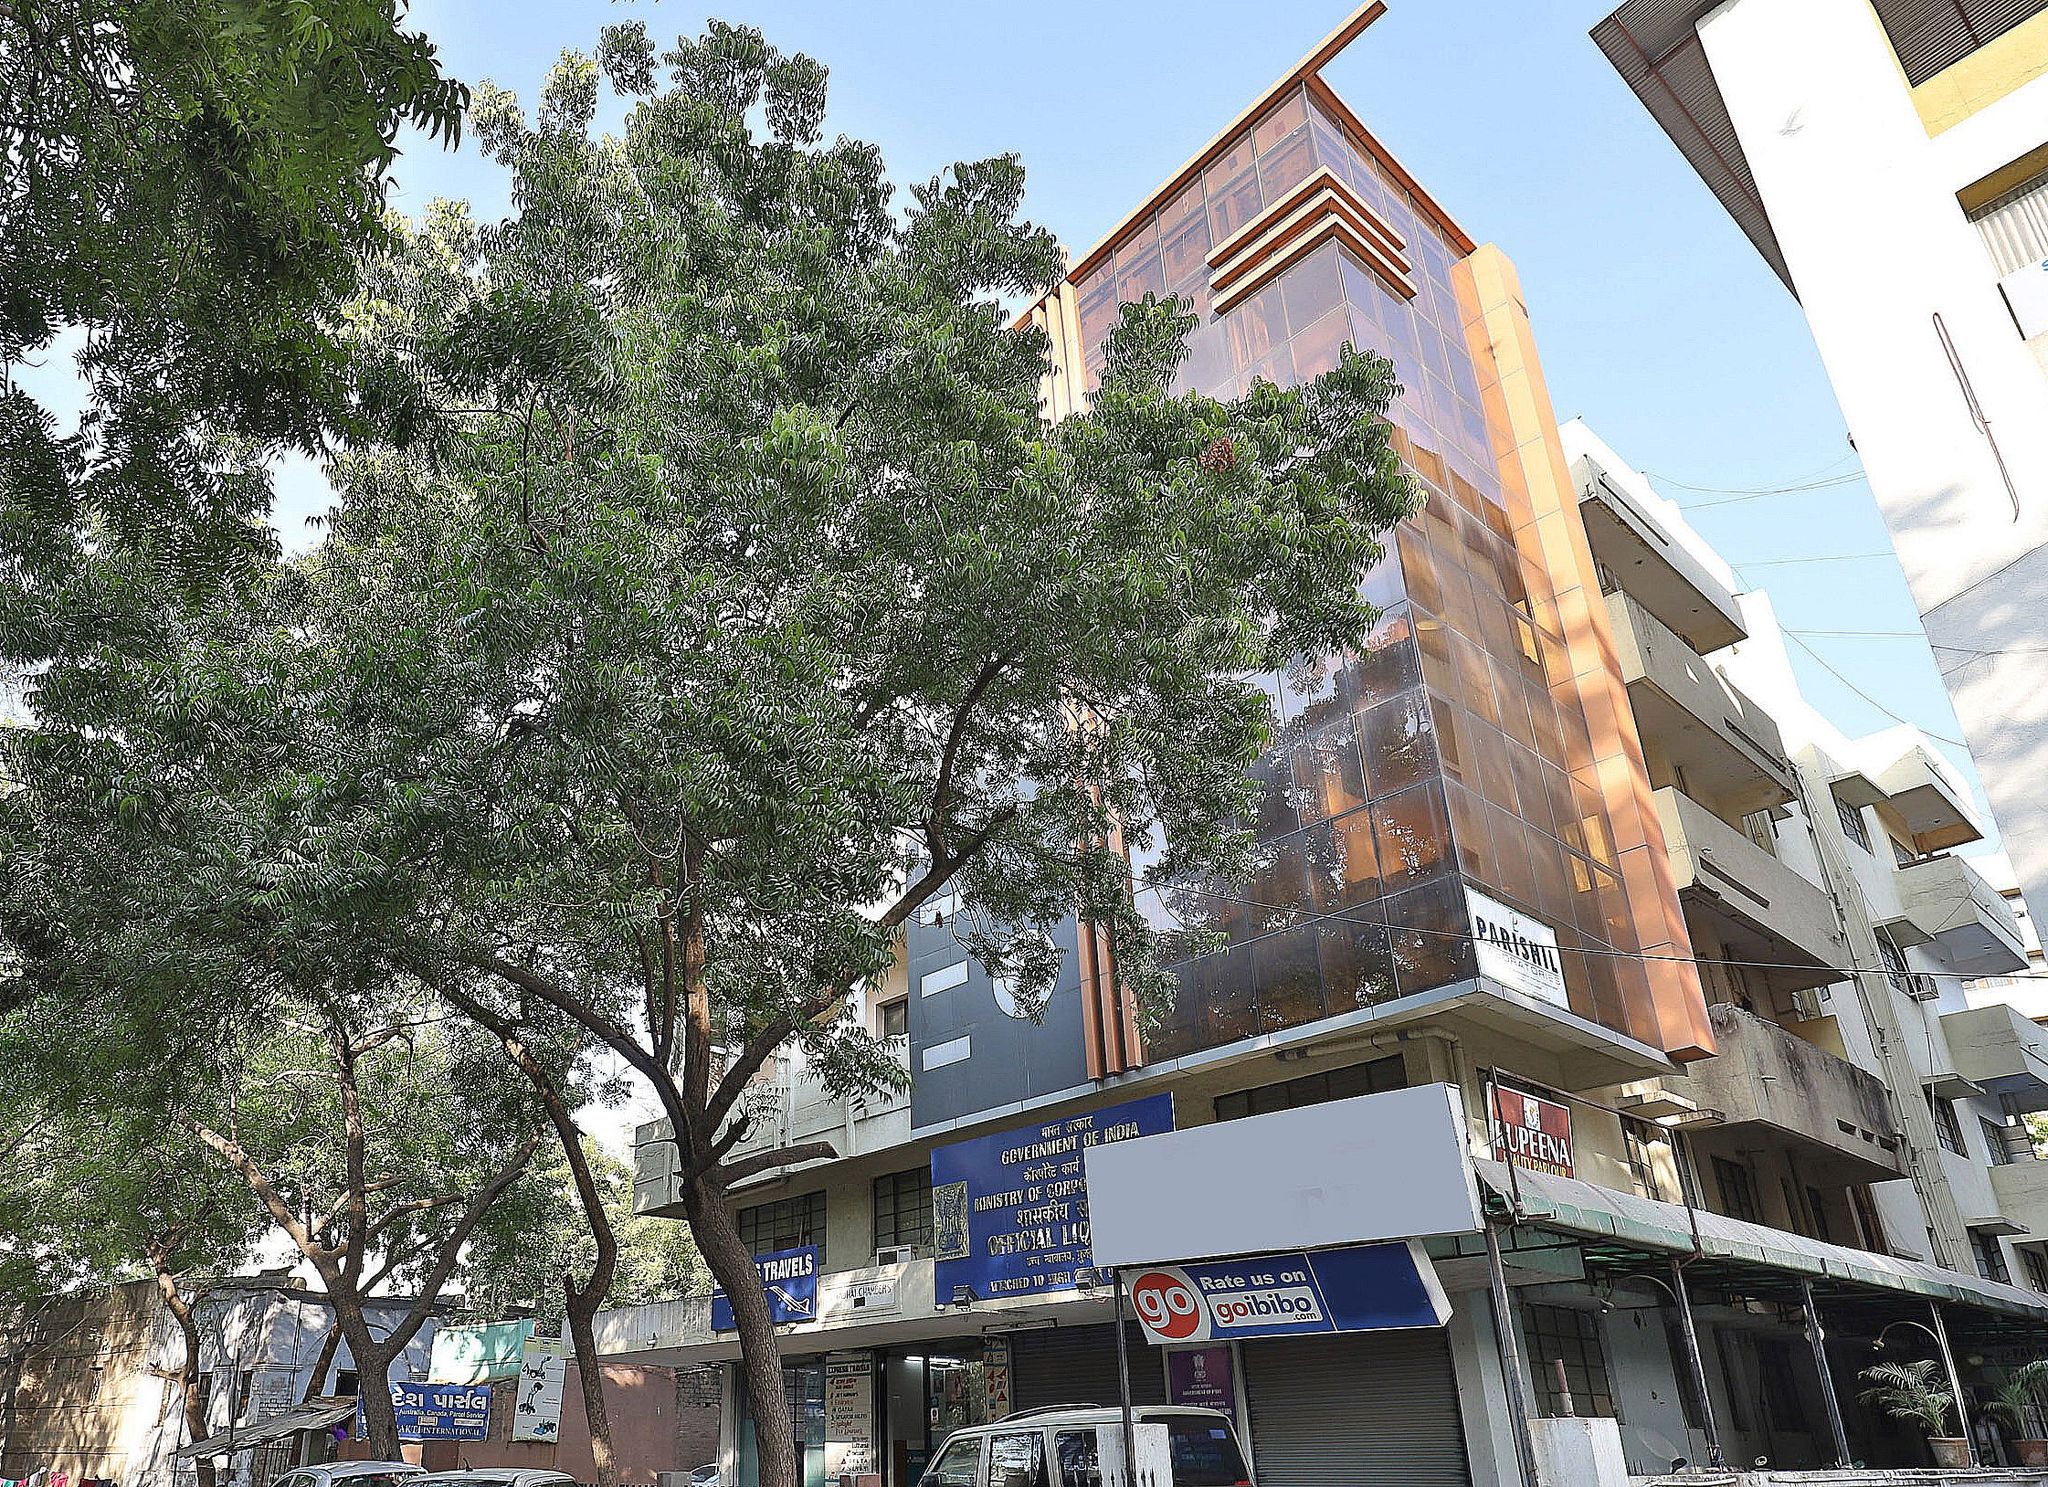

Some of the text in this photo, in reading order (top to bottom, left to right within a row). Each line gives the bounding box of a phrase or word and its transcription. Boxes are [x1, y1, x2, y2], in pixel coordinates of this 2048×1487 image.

[1476, 916, 1559, 973] PARISHIL
[1001, 1121, 1139, 1165] GOVERNMENT OF INDIA
[1495, 1119, 1572, 1167] RUPEENA
[975, 1189, 1024, 1212] MINISTRY
[1028, 1186, 1042, 1202] OF
[987, 1227, 1057, 1257] OFFICIAL
[763, 1254, 813, 1282] TRAVELS
[1033, 1274, 1045, 1287] TO
[1200, 1269, 1307, 1291] Rate us on
[1138, 1286, 1195, 1329] go
[1216, 1292, 1313, 1325] goibibo
[1292, 1311, 1318, 1322] .com
[399, 1409, 426, 1417] Australia,
[449, 1410, 465, 1418] Parcel
[466, 1411, 486, 1419] Service
[422, 1426, 482, 1437] INTERNATIONAL
